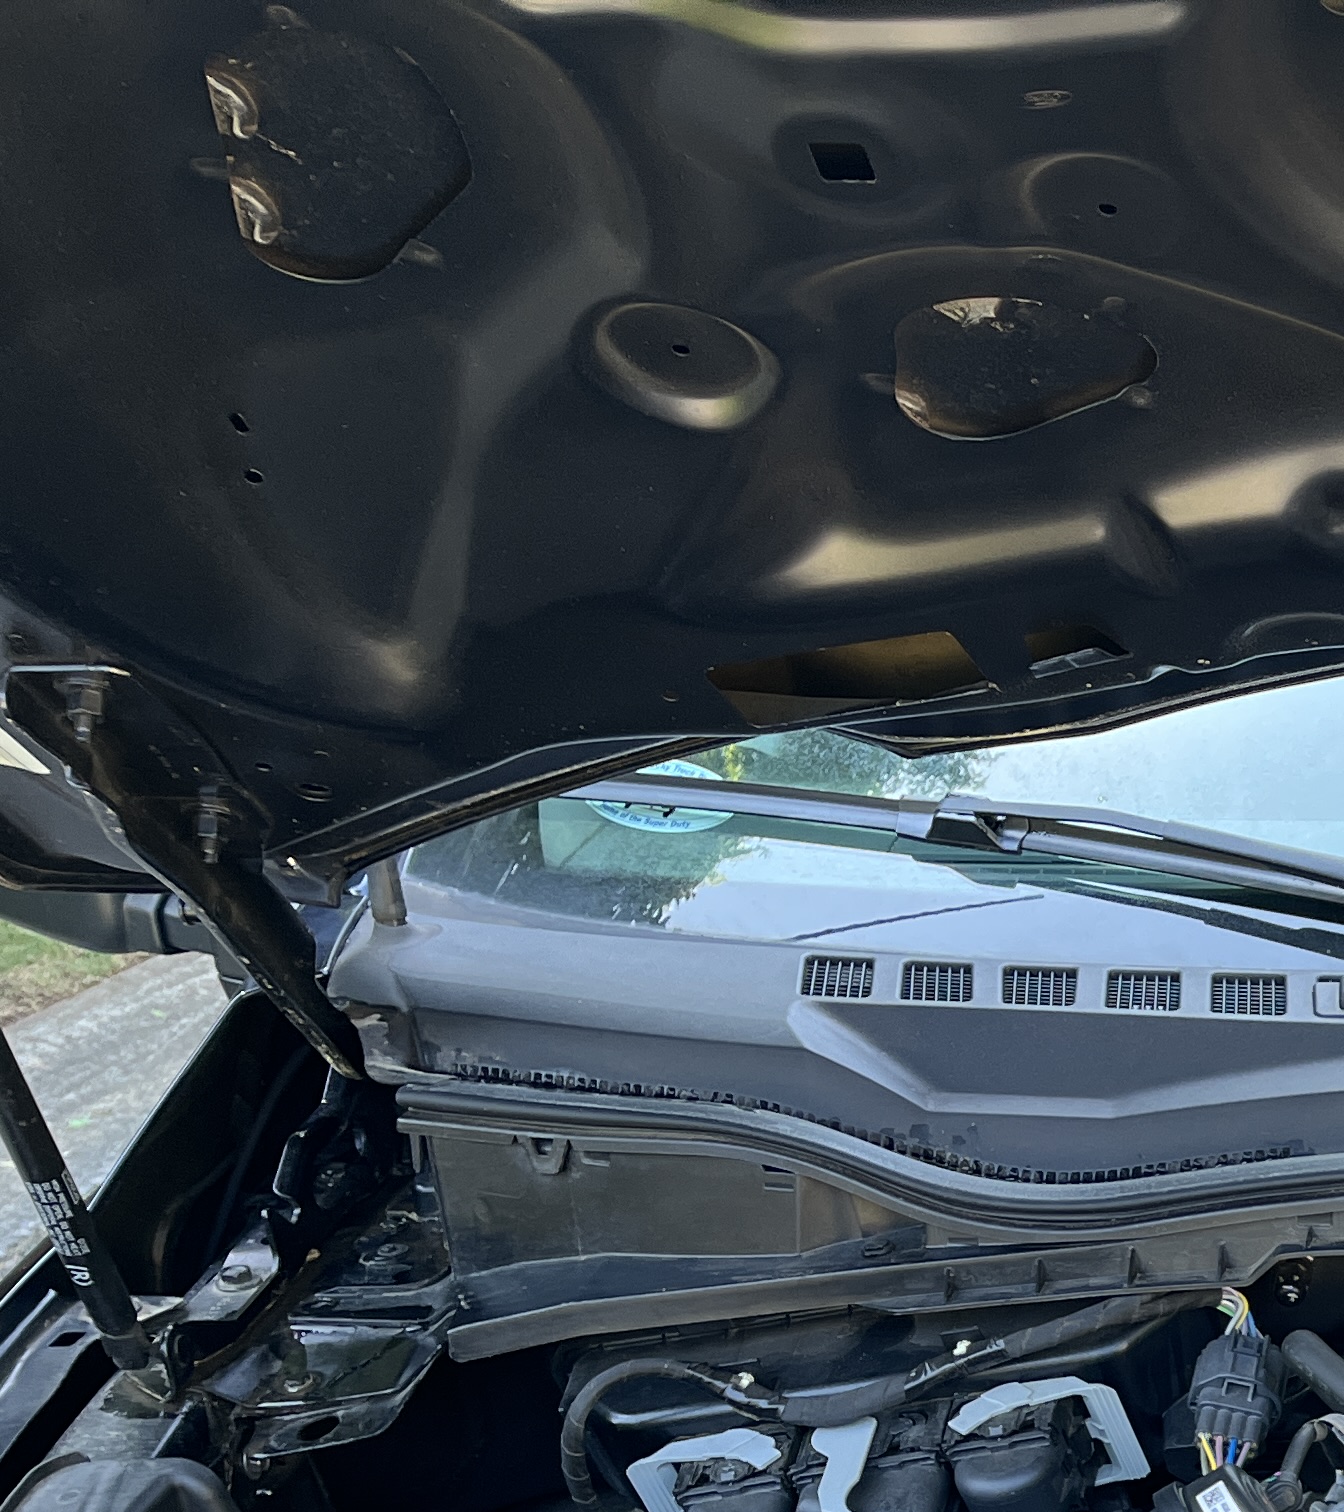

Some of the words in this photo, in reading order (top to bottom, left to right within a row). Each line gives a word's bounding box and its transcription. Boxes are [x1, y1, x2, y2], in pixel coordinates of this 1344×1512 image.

[629, 812, 642, 822] the
[643, 817, 667, 828] Super
[670, 819, 691, 829] Duty
